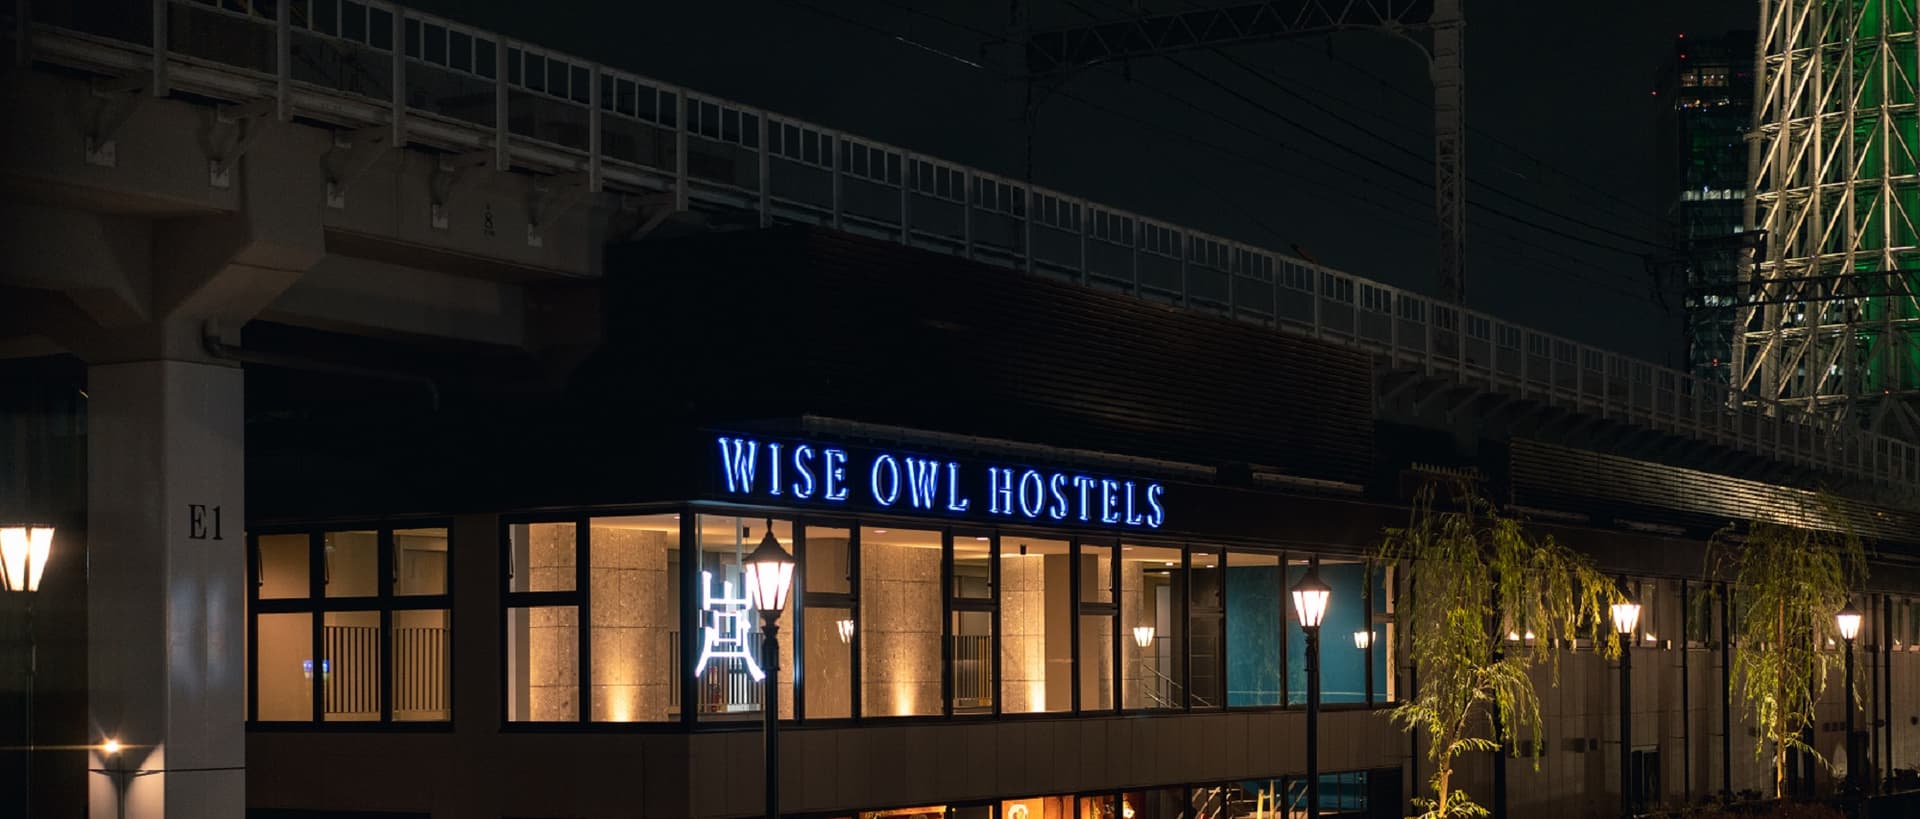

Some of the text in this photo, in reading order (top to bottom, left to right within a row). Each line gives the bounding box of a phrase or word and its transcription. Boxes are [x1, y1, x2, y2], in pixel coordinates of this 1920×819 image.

[718, 436, 1164, 528] WISE OWL HOSTELS
[188, 503, 223, 541] E1
